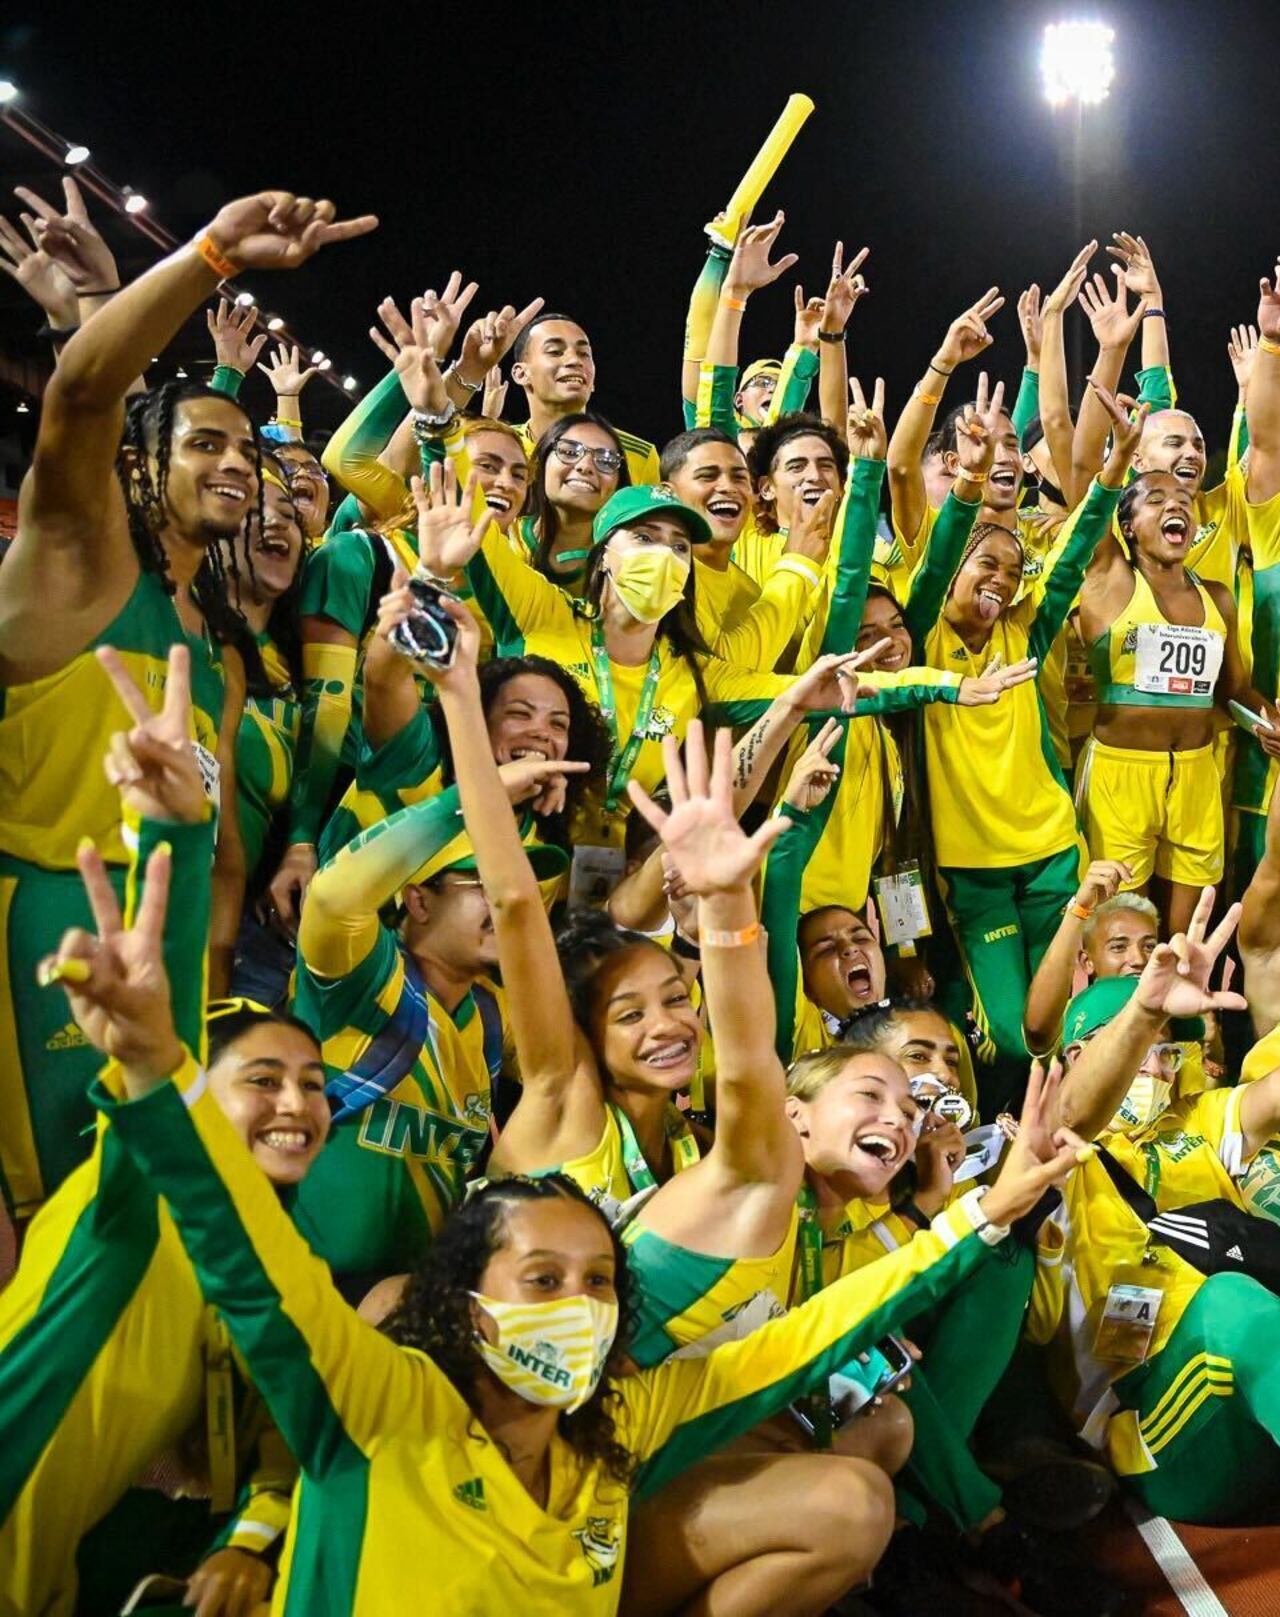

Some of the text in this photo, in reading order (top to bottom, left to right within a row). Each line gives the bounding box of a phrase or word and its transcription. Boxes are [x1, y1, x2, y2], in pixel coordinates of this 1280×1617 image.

[1159, 640, 1206, 676] 209
[983, 923, 1018, 944] INTER
[1169, 1135, 1208, 1163] INTER
[1136, 1302, 1151, 1320] A
[507, 1343, 572, 1388] INTER
